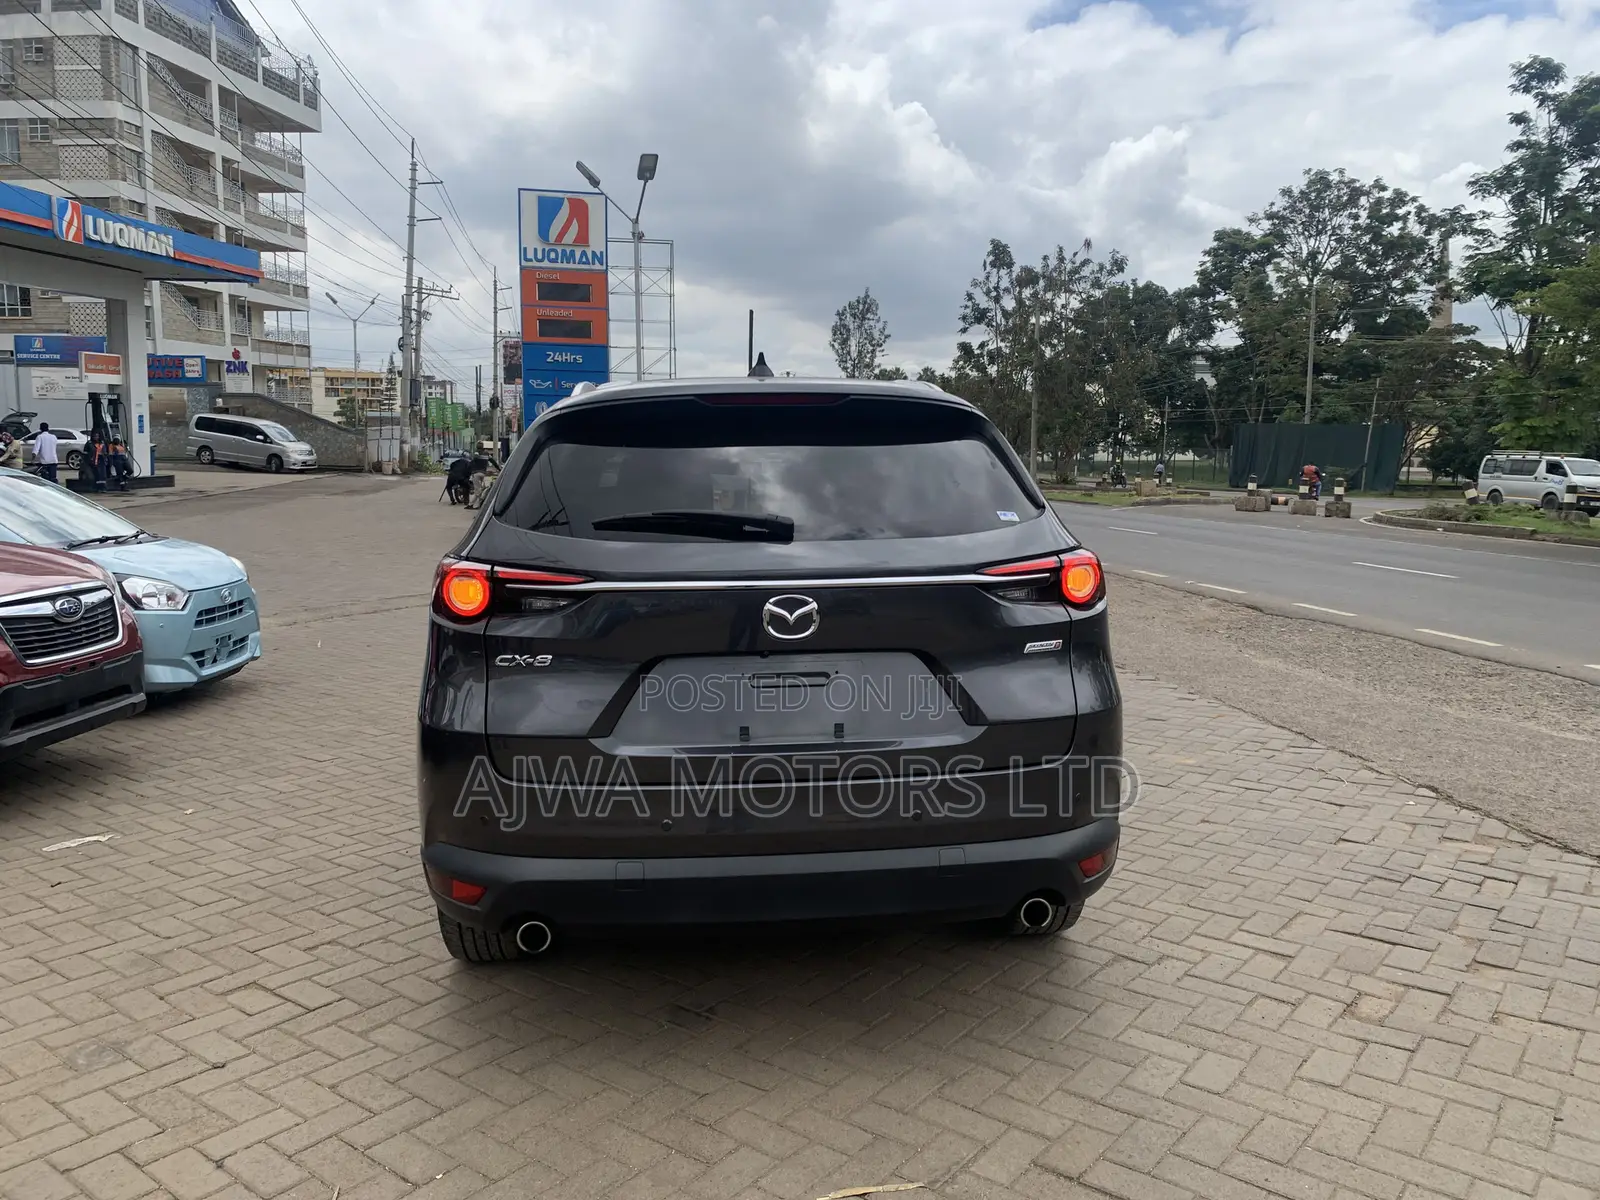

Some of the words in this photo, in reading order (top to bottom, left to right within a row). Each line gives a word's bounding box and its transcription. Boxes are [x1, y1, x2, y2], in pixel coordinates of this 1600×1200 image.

[84, 214, 174, 258] LUQMAN
[523, 246, 604, 266] LUQMAN
[536, 271, 560, 280] Diesel
[536, 308, 573, 317] Unleaded
[546, 351, 583, 363] 24Hrs
[225, 360, 249, 374] ZNK
[495, 654, 553, 667] CX-8
